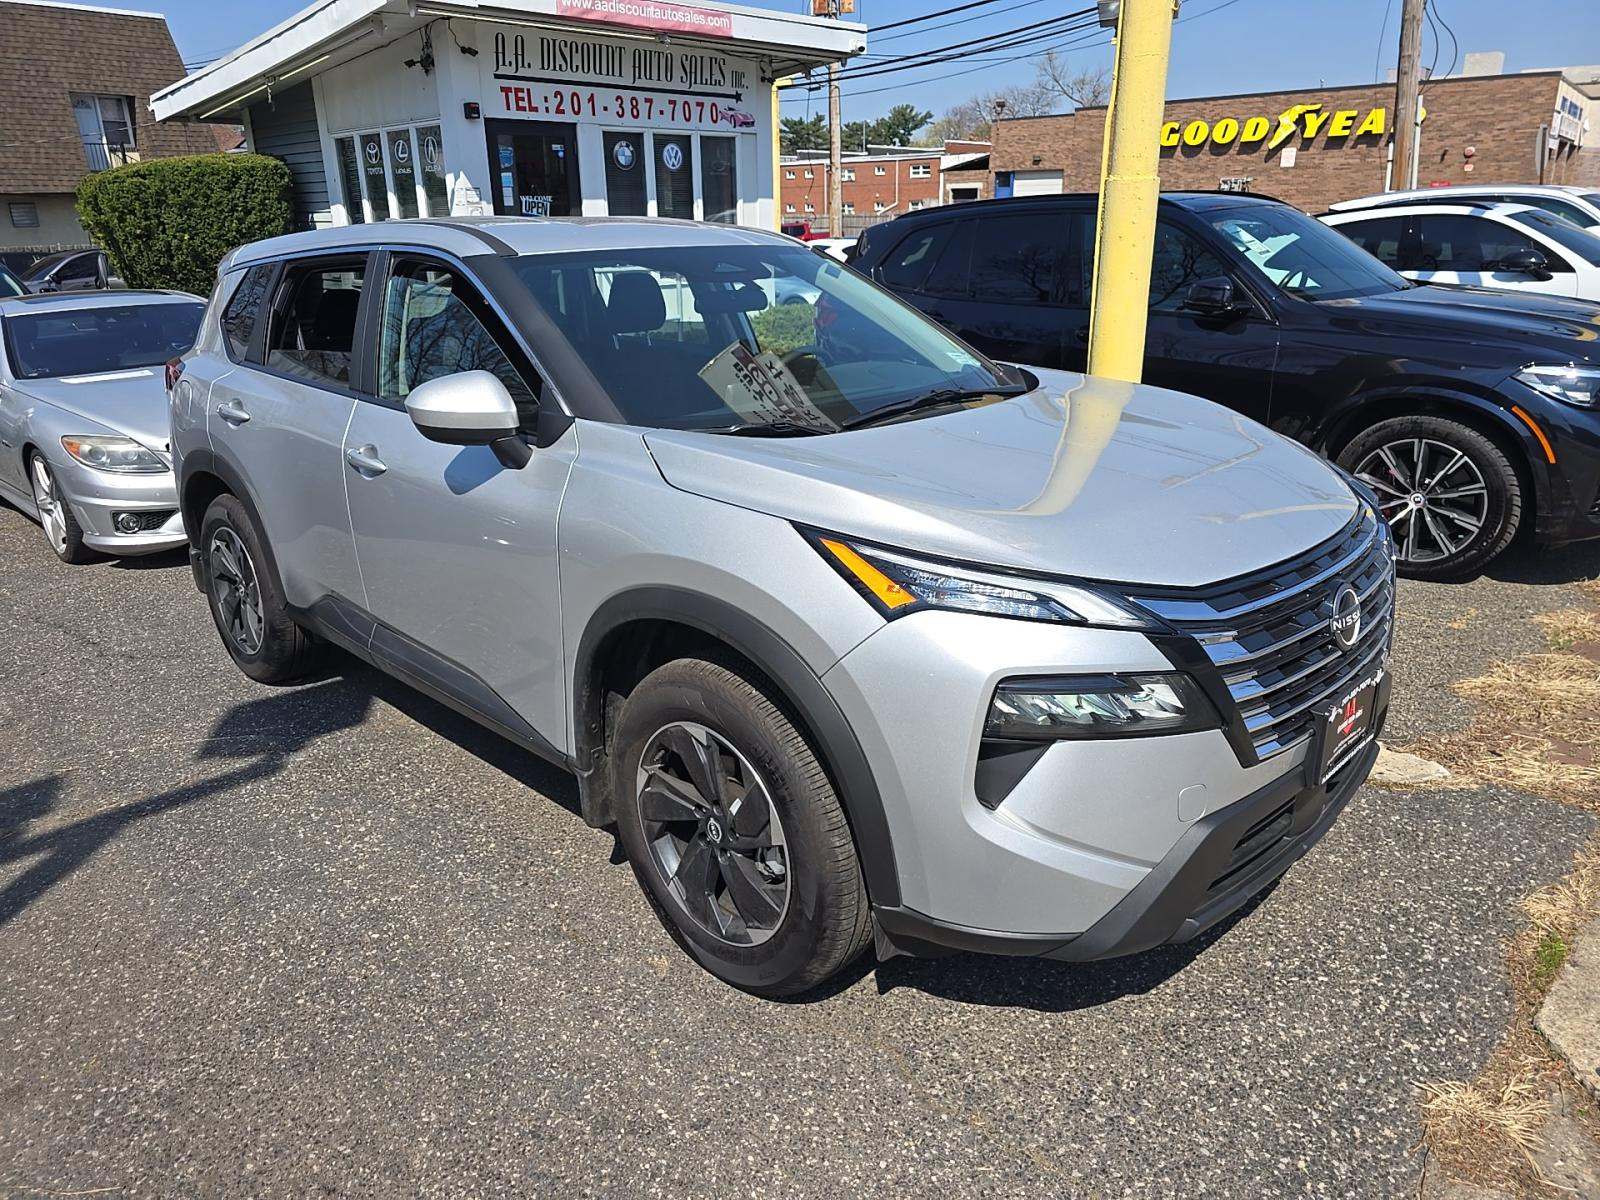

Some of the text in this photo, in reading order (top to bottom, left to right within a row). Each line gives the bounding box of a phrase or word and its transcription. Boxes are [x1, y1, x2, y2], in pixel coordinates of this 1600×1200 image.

[561, 0, 730, 28] www.aadiscountautosales.com
[494, 32, 531, 74] A.A.
[539, 37, 626, 78] DISCOUNT
[632, 49, 673, 85] AUTO
[680, 52, 726, 89] SALES
[1333, 610, 1361, 631] NISS
